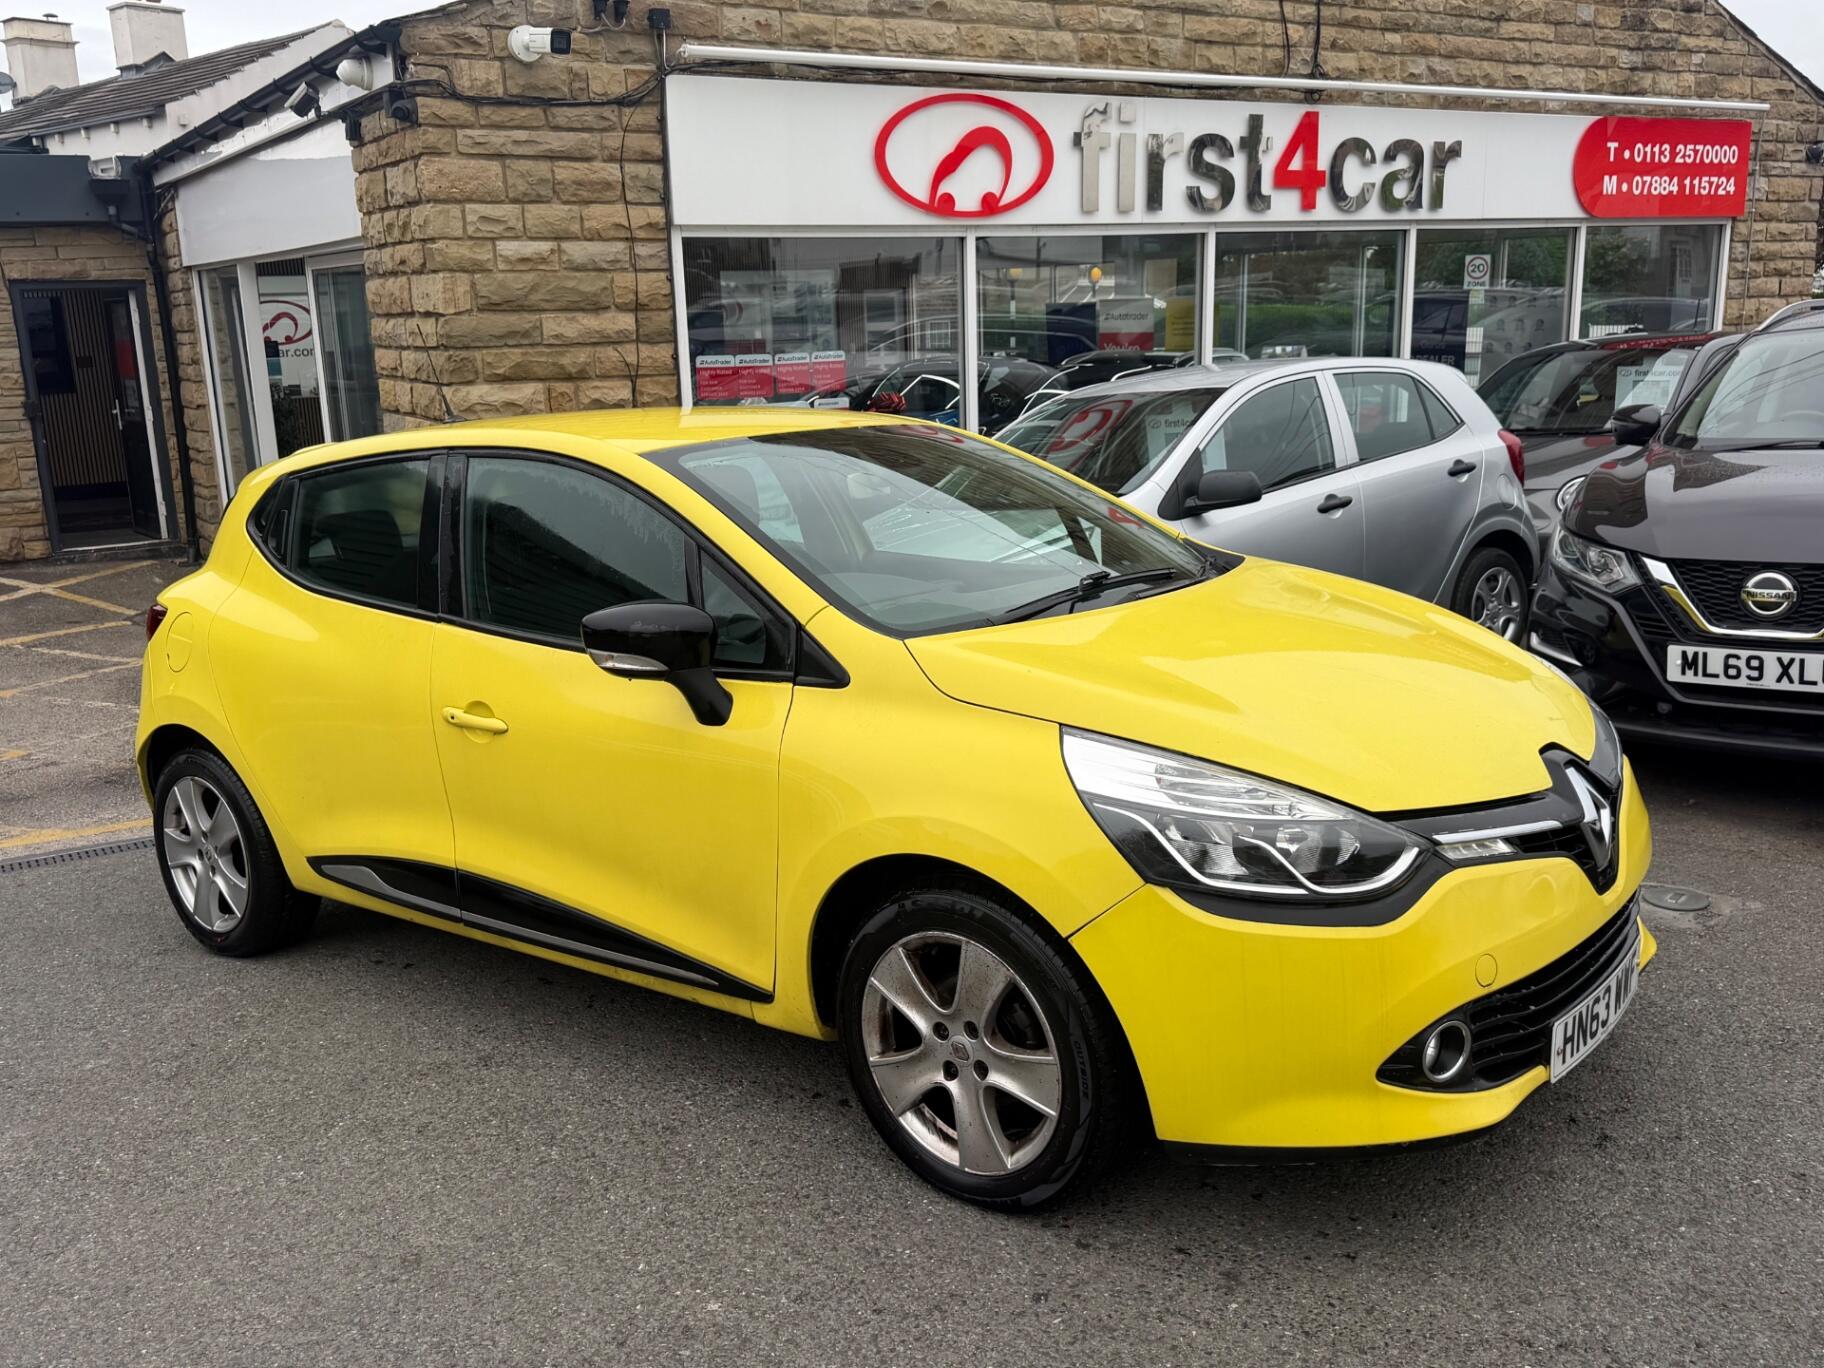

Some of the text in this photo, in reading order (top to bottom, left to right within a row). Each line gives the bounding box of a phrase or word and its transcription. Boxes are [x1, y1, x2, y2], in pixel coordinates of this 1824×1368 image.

[1073, 102, 1463, 213] first4car
[1606, 141, 1739, 164] T 0113 2570000
[1602, 175, 1736, 196] M 07884 115724
[1470, 263, 1486, 274] 20
[1746, 590, 1791, 601] NISSAN
[1681, 650, 1824, 686] ML69 XL
[1562, 983, 1612, 1066] HN63
